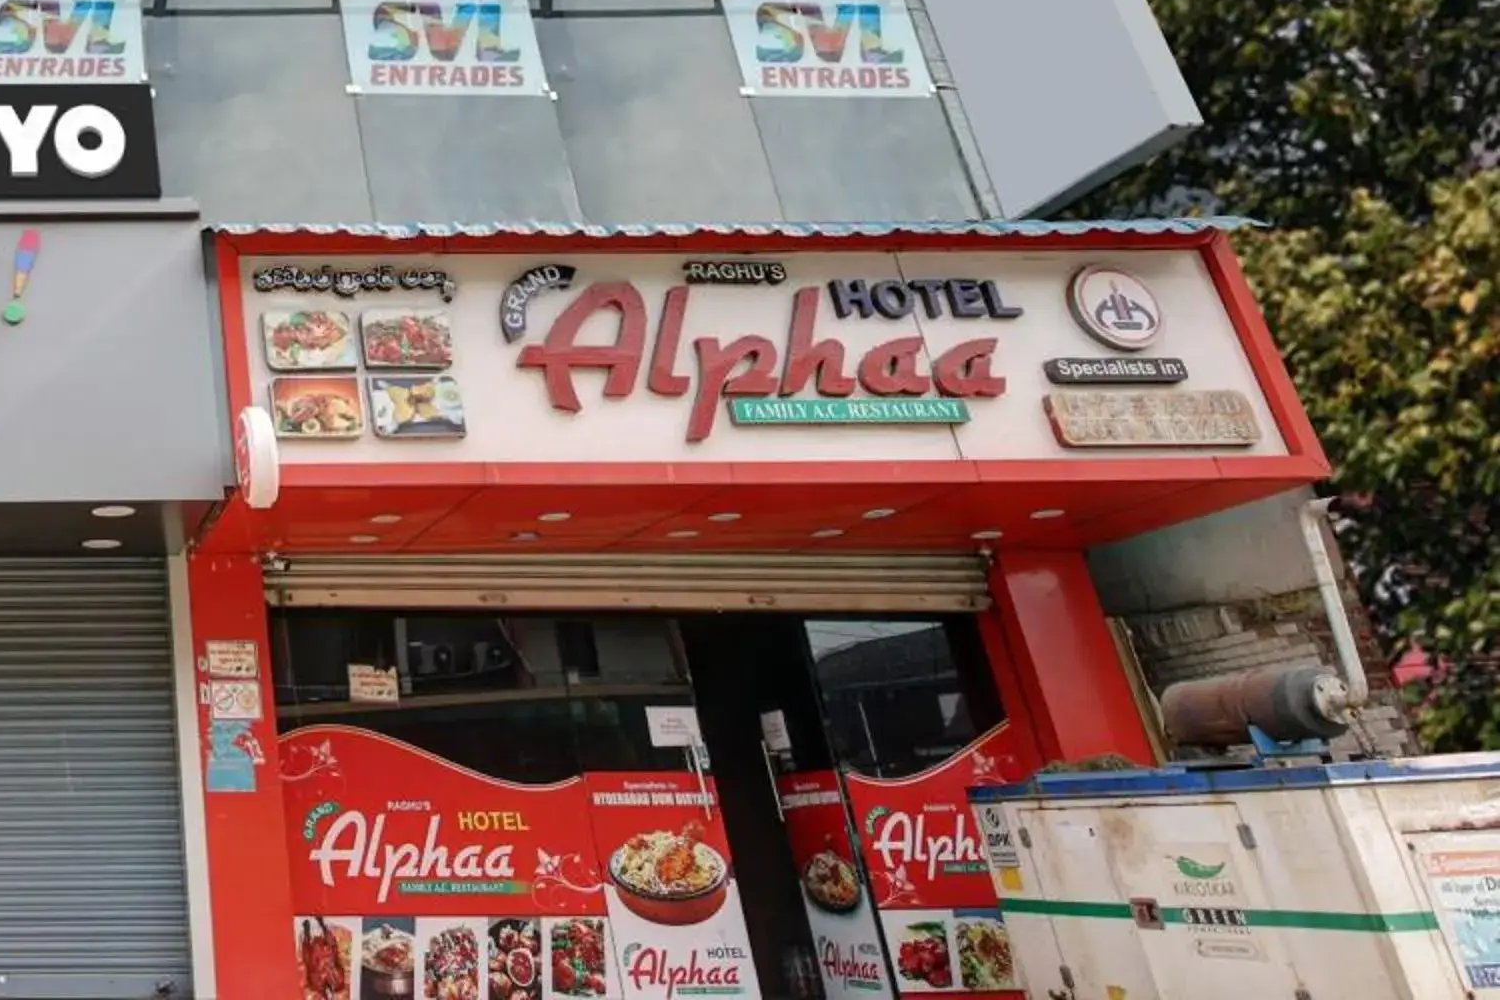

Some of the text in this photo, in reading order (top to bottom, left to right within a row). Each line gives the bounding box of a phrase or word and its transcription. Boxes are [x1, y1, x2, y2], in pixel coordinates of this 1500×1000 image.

[368, 2, 521, 61] SVL
[756, 3, 905, 62] SVL
[370, 64, 524, 87] ENTRADES
[761, 67, 910, 89] ENTRADES
[690, 263, 785, 283] RAGHU'S
[829, 279, 1023, 320] HOTEL
[516, 281, 1006, 443] Alphaa
[1057, 360, 1157, 378] Specialists
[743, 402, 808, 420] FAMILY
[851, 402, 963, 420] RESTAURANT
[457, 811, 531, 831] HOTEL
[309, 810, 515, 903] Alphaa
[706, 946, 747, 959] HOTEL
[628, 947, 740, 999] Alphaa
